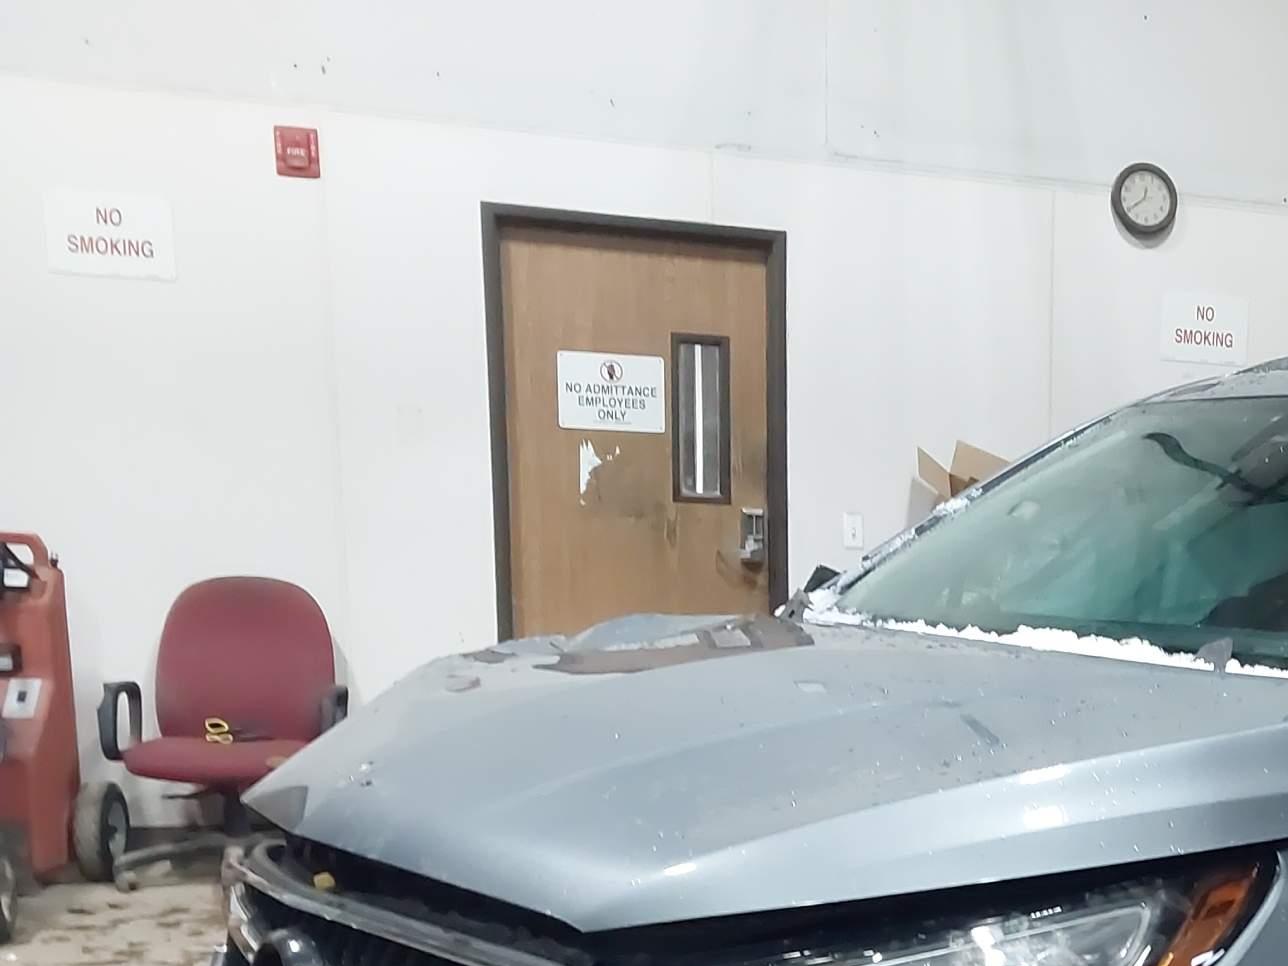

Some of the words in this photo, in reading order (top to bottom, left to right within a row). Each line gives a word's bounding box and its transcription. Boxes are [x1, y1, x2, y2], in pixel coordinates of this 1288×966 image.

[95, 206, 122, 227] NO
[67, 233, 154, 259] SMOKING
[1196, 305, 1215, 322] NO
[1175, 328, 1233, 348] SMOKING
[565, 382, 582, 393] NO
[585, 383, 657, 398] ADMITTANCE
[578, 396, 647, 410] EMPLOYEES
[597, 409, 627, 422] ONLY
